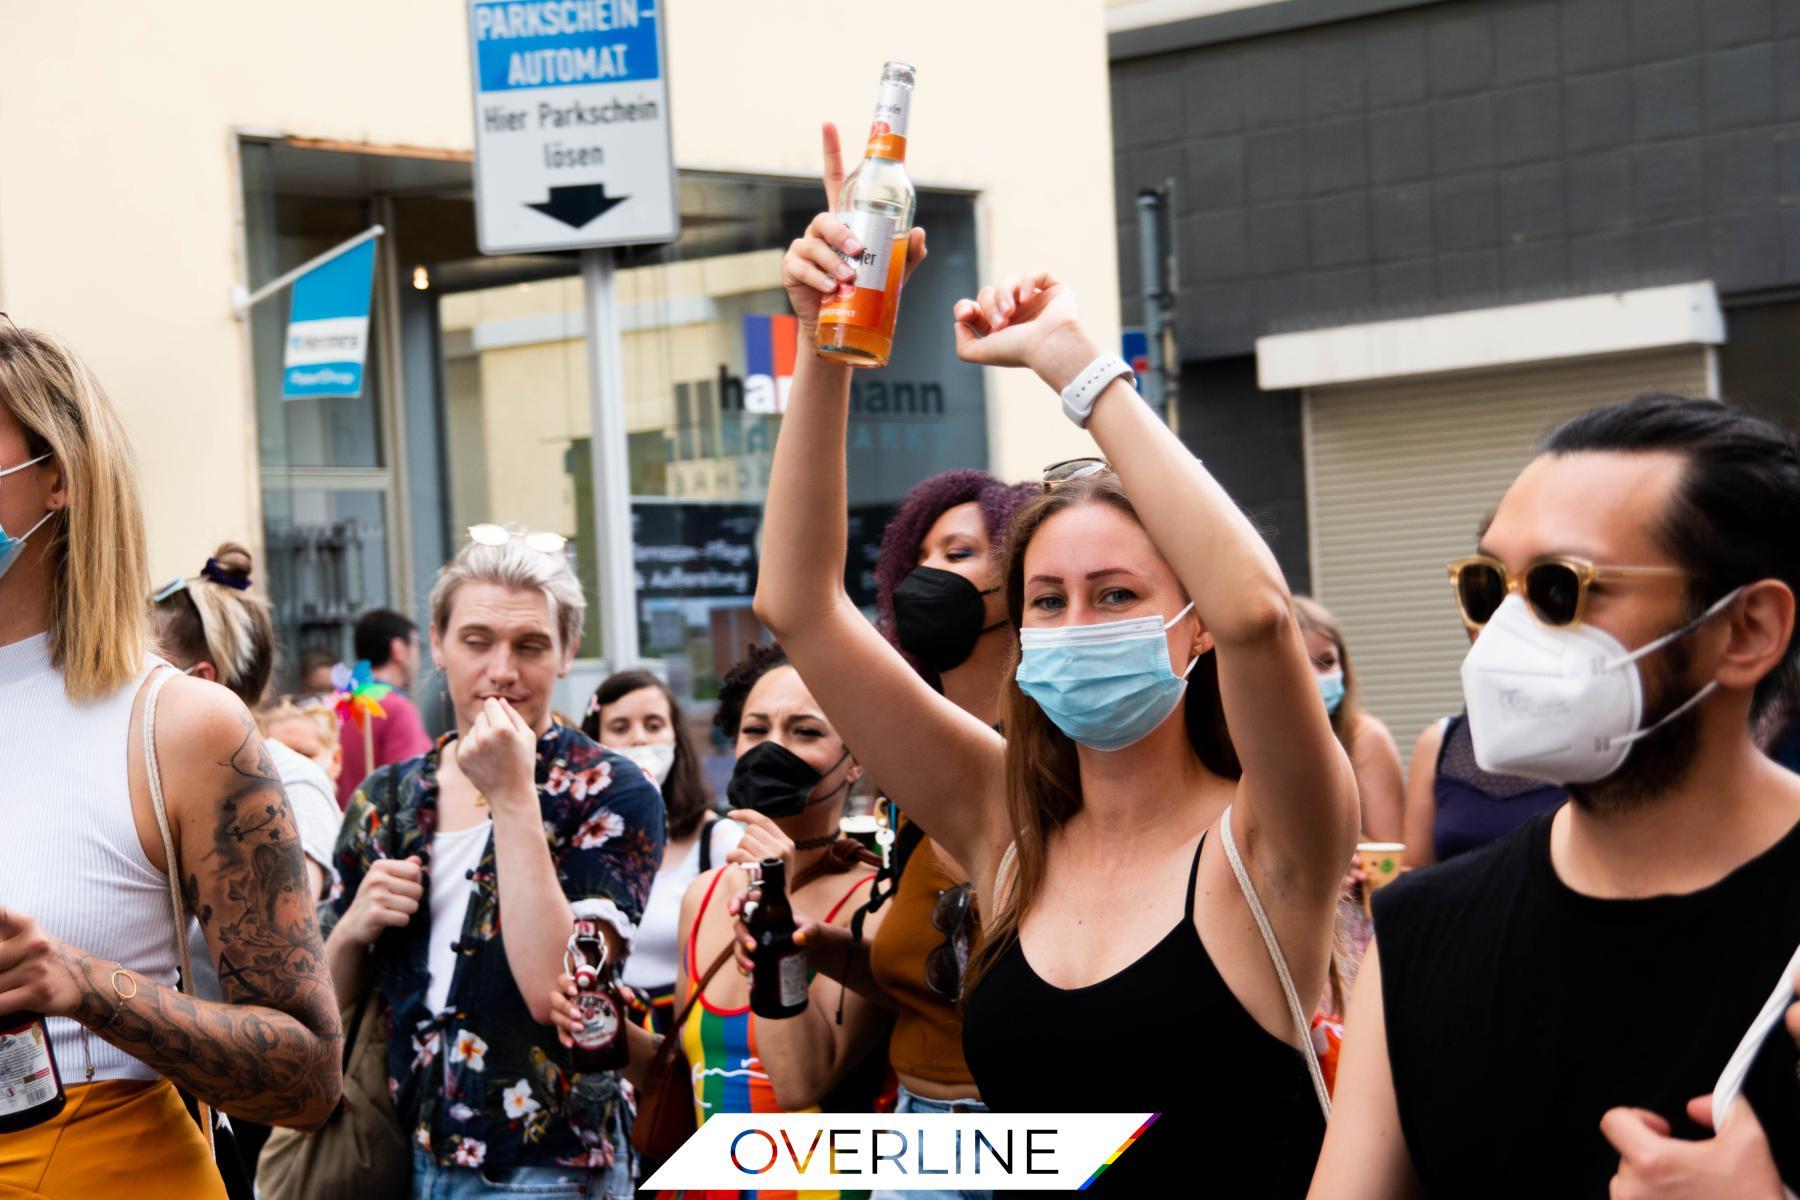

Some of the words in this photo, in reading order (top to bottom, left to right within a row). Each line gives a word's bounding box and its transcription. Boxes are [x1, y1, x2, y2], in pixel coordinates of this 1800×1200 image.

[476, 0, 657, 40] PARKSCHEIN-
[508, 43, 629, 86] AUTOMAT
[484, 105, 528, 132] Hier
[538, 95, 658, 128] Parkschein
[544, 141, 604, 169] lösen
